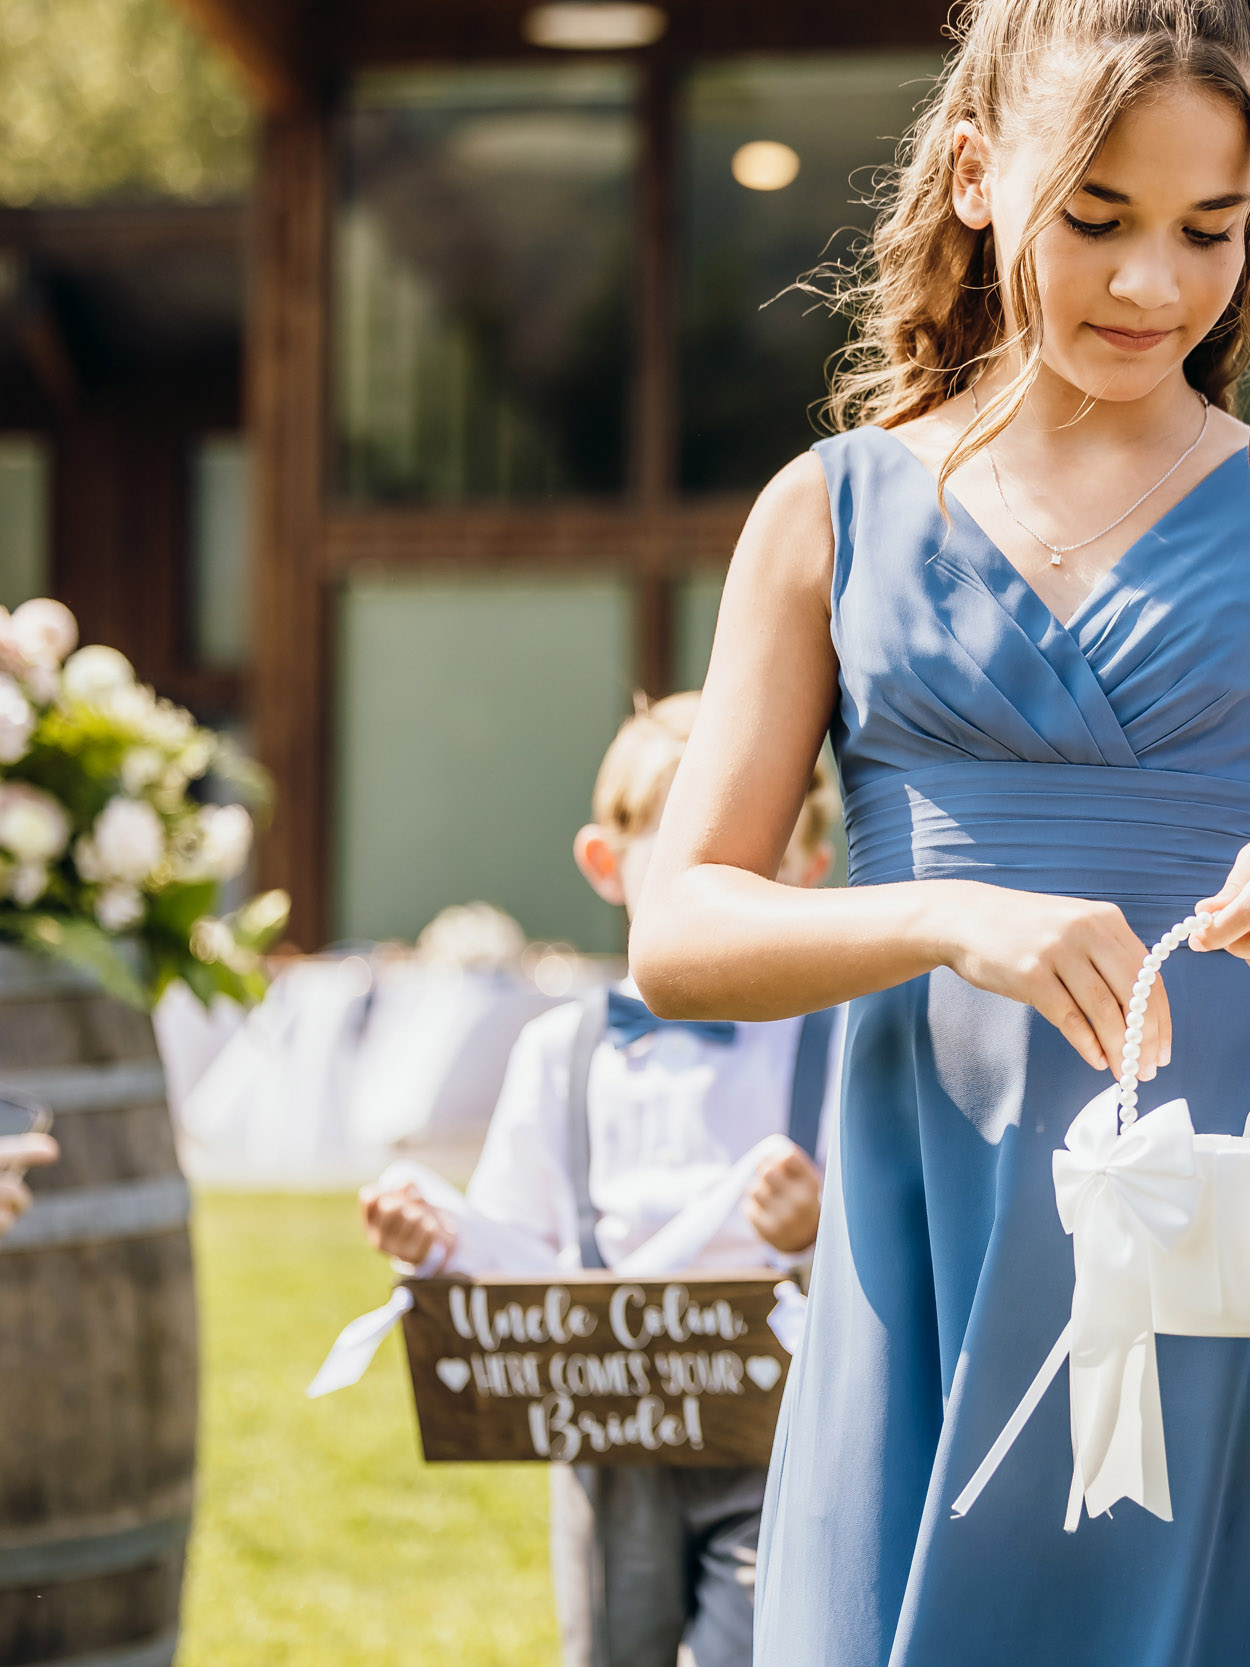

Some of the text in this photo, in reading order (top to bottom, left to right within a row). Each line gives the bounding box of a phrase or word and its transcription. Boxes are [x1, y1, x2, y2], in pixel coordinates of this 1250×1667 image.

[449, 1285, 597, 1351] Uncle
[471, 1350, 745, 1397] HERE COMES YOUR
[528, 1391, 704, 1464] Bride!
